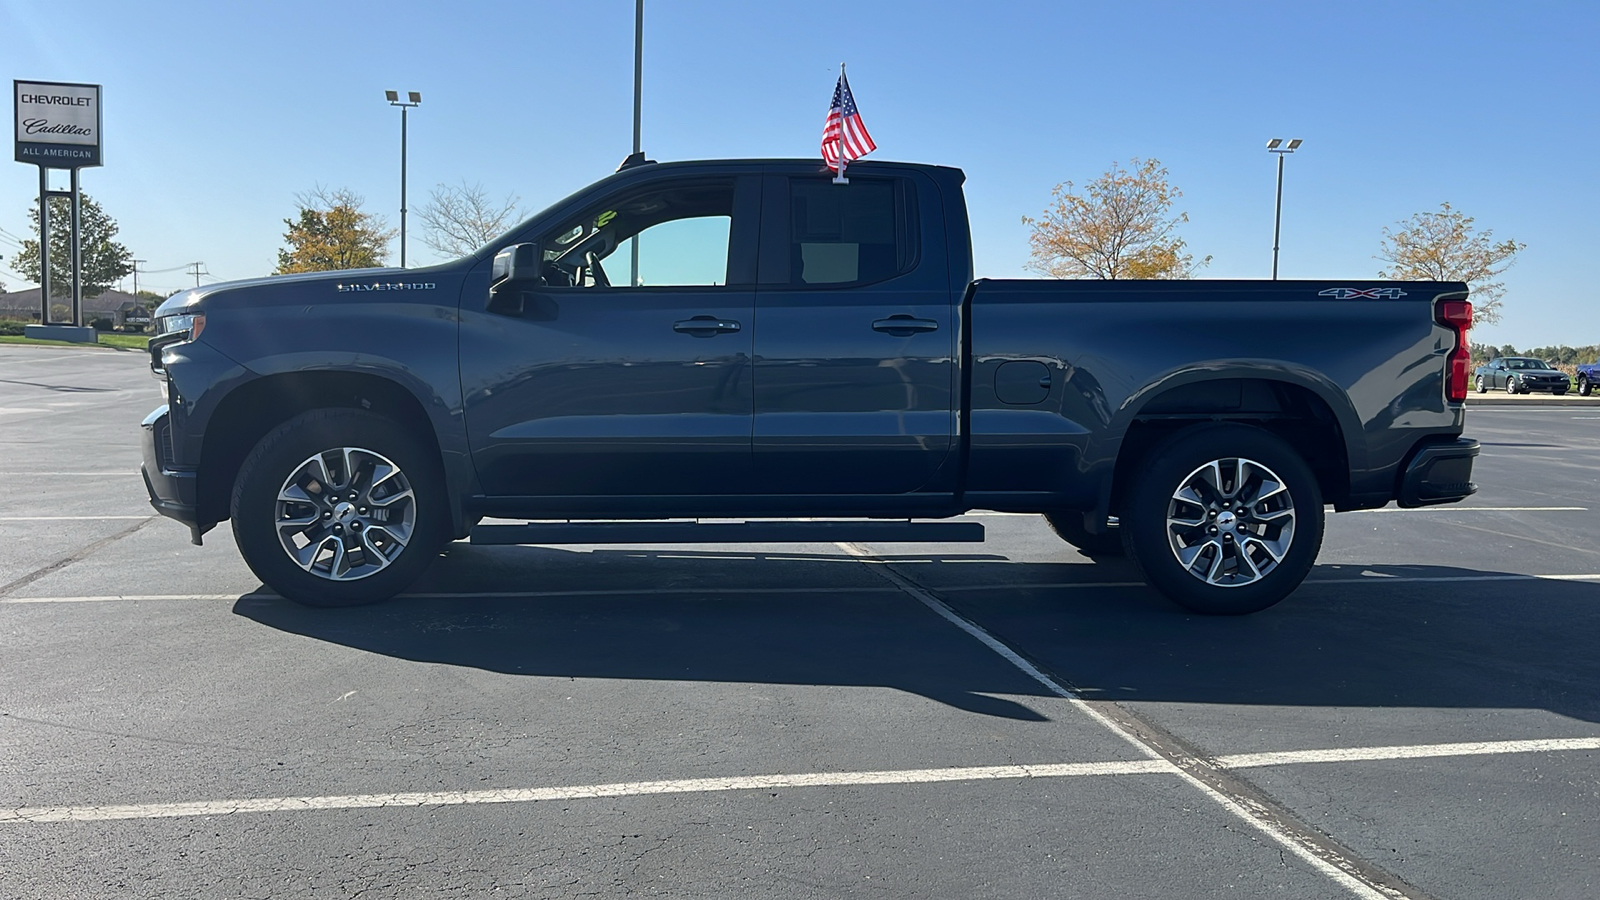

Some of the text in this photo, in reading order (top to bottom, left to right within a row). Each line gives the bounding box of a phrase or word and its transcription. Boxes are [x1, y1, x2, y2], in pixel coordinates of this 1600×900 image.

[21, 94, 92, 106] CHEVROLET
[22, 118, 92, 136] Cadillac
[22, 147, 92, 158] ALL AMERICAN
[337, 283, 436, 292] SILVERADO
